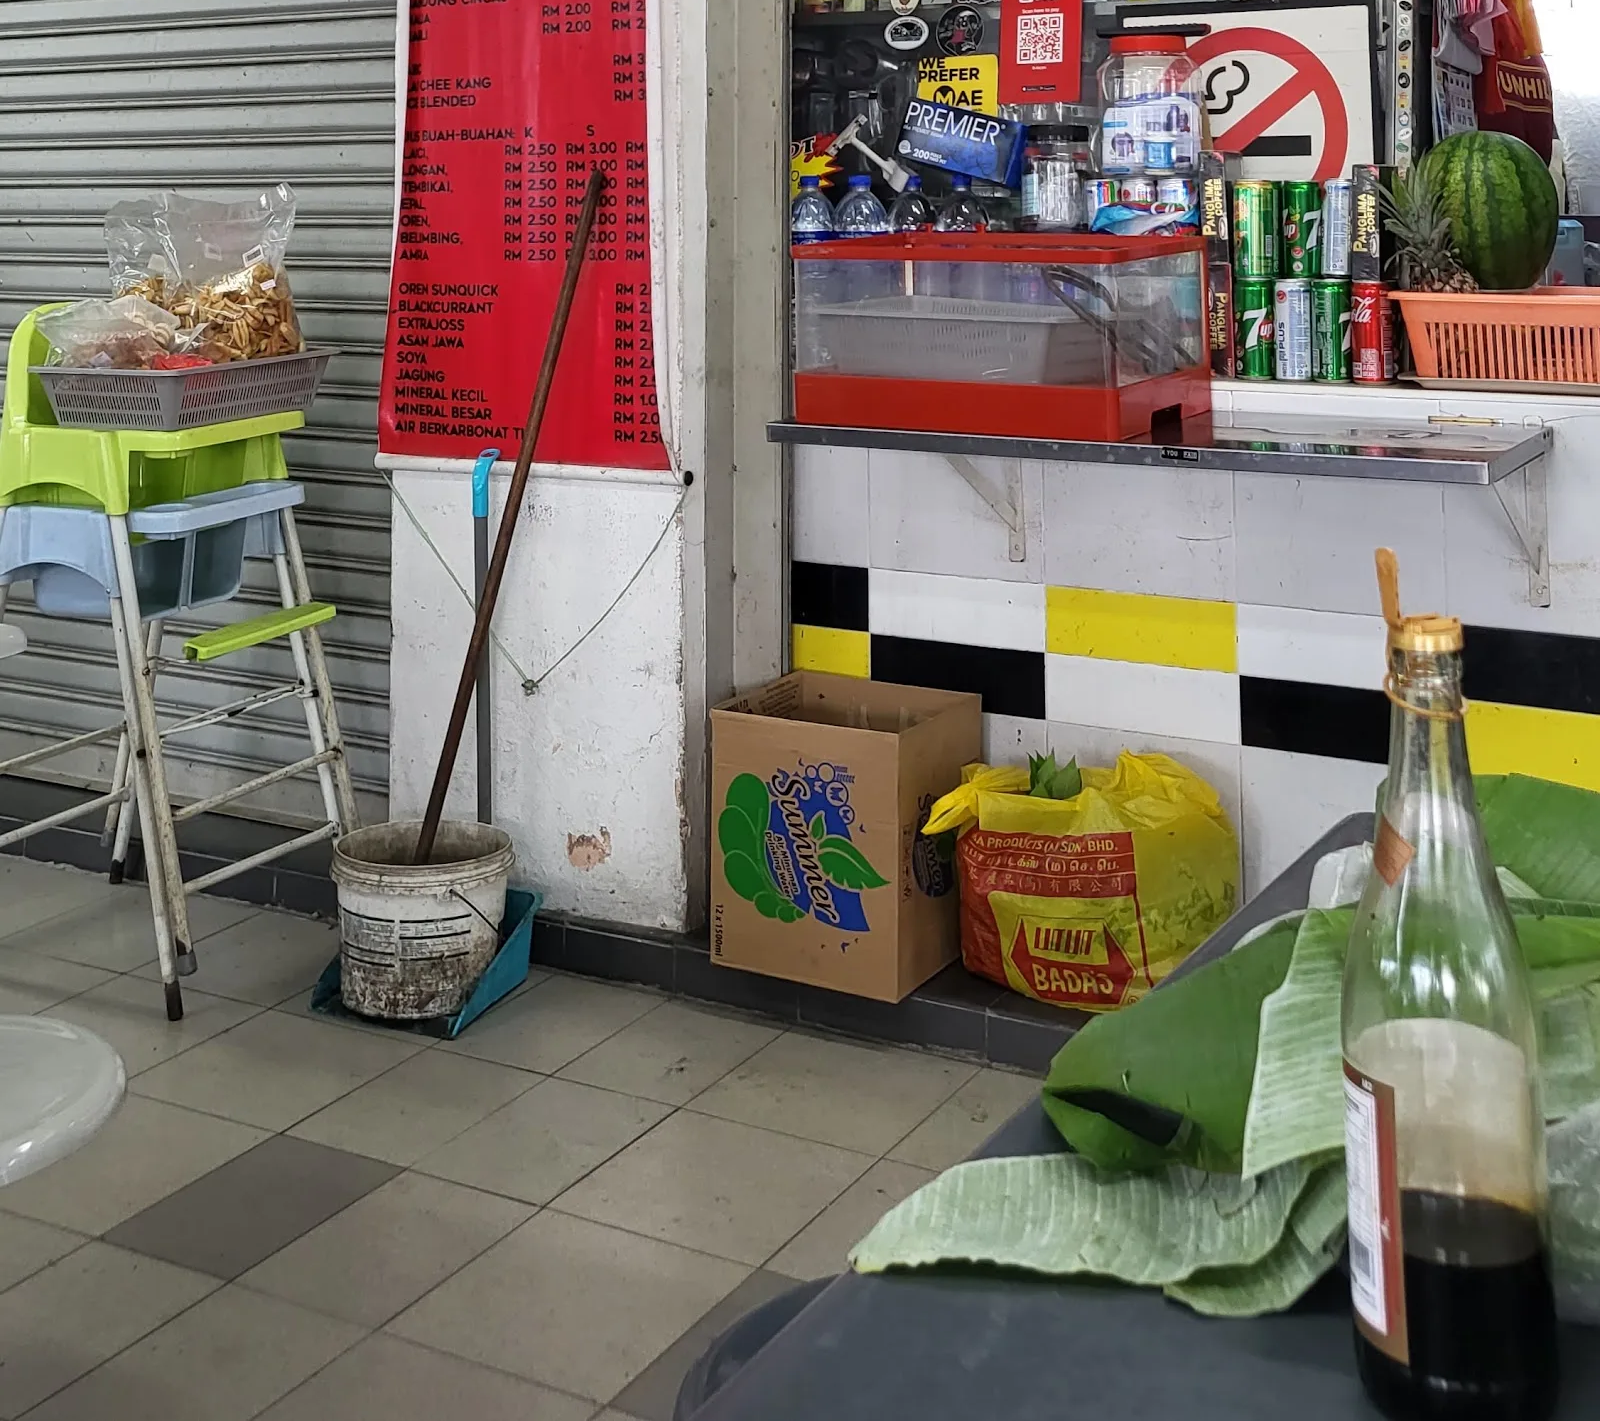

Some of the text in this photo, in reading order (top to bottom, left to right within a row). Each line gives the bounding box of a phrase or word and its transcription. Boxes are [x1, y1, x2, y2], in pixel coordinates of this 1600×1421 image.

[542, 3, 591, 17] RM 2.00
[543, 20, 591, 35] RM 2.00
[921, 58, 945, 69] WE
[919, 68, 979, 83] PREFER
[420, 77, 491, 91] CHEE KANG
[420, 95, 476, 109] BLENDED
[934, 86, 983, 106] MAE
[905, 101, 1000, 146] PREMIER
[525, 127, 534, 138] K
[586, 125, 595, 137] S
[505, 145, 523, 156] RM
[528, 144, 556, 157] 2.50
[566, 142, 584, 154] RM
[589, 141, 617, 154] 3.00
[913, 148, 930, 160] 200
[505, 162, 522, 173] RM
[528, 161, 556, 173] 2.50
[566, 160, 585, 172] RM
[505, 179, 522, 191] RM
[528, 179, 556, 191] 2.50
[505, 196, 556, 208] RM 2.50
[1213, 178, 1223, 217] COFFEE
[1202, 178, 1217, 236] PANGLIMA
[1366, 194, 1376, 234] COFFEE
[504, 214, 522, 226] RM
[528, 214, 556, 226] 2.50
[1353, 193, 1368, 252] PANGLIMA
[1303, 208, 1322, 251] 7
[504, 231, 522, 244] RM
[528, 231, 556, 243] 2.50
[590, 231, 617, 243] 3.00
[400, 248, 617, 261] AMRA RM 2.50 3.00
[398, 282, 498, 297] OREN SUNQUICK
[398, 300, 494, 314] BLACKCURRANT
[398, 317, 465, 331] EXTRAJOSS
[1215, 292, 1228, 351] PANGLIMA
[1209, 312, 1217, 351] COFFEE
[397, 335, 465, 349] ASAM JAWA
[397, 352, 427, 365] SOYA
[396, 370, 445, 383] JAGUNG
[395, 386, 657, 406] MINERAL KECIL RM 1.0
[395, 403, 659, 425] MINERAL BESAR RM 2.0
[395, 421, 416, 433] AIR
[419, 422, 508, 440] BERKARBONAT
[614, 430, 634, 443] RM
[772, 774, 839, 922] Summer
[987, 836, 1044, 850] PRODUCTS
[1087, 839, 1119, 852] BHD.
[765, 831, 793, 900] Drinking Water
[775, 835, 799, 894] Air Minuman
[715, 904, 724, 914] 12
[715, 924, 723, 957] 1500ml
[1032, 963, 1114, 994] BADAS
